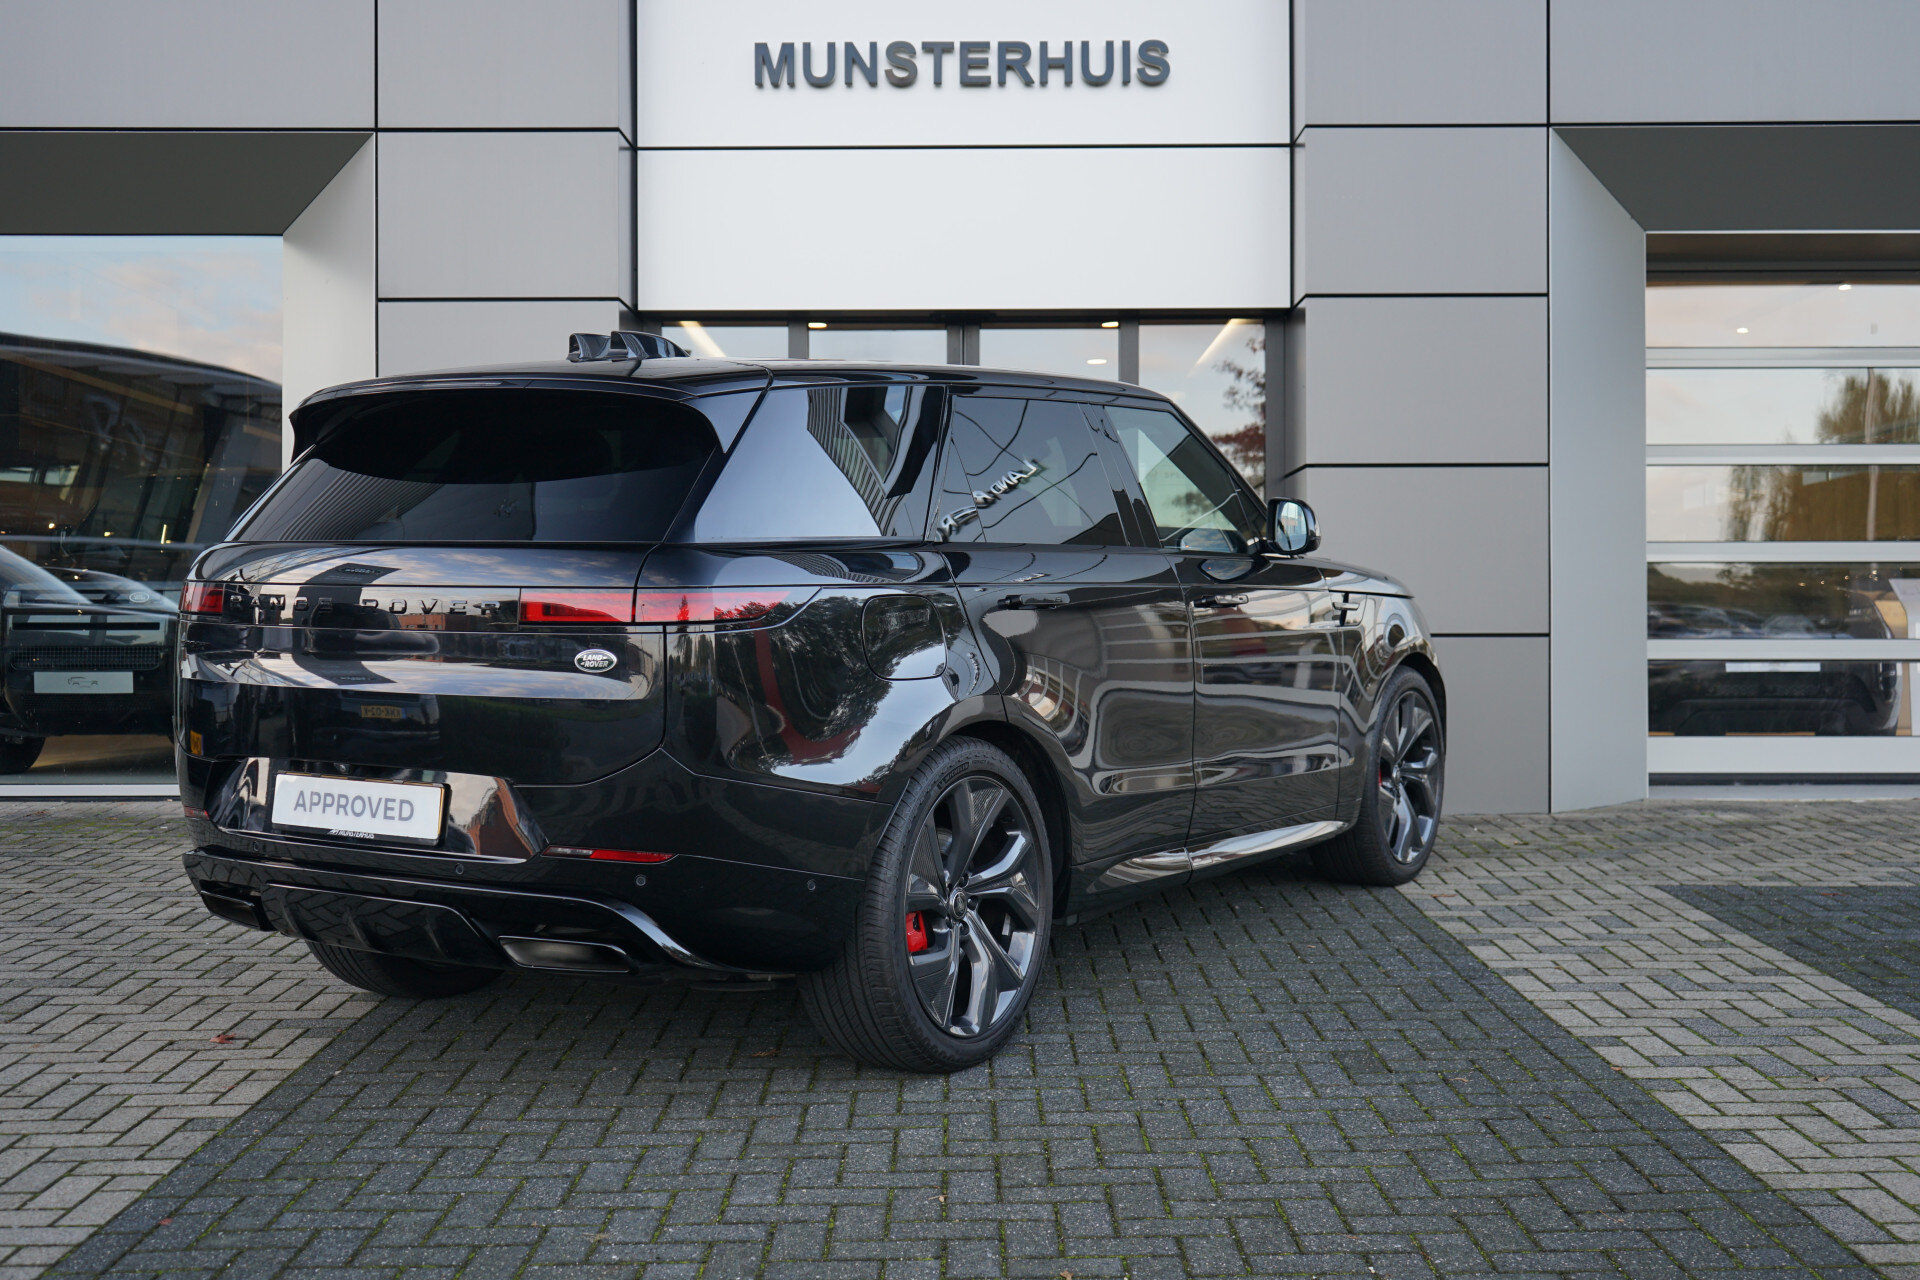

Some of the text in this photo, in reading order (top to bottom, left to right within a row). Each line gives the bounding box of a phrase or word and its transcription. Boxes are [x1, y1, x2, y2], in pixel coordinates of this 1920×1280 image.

[754, 40, 1171, 87] MUNSTERHUIS
[229, 594, 500, 615] RANGE ROVER
[584, 660, 609, 668] ROVER
[294, 790, 415, 822] APPROVED
